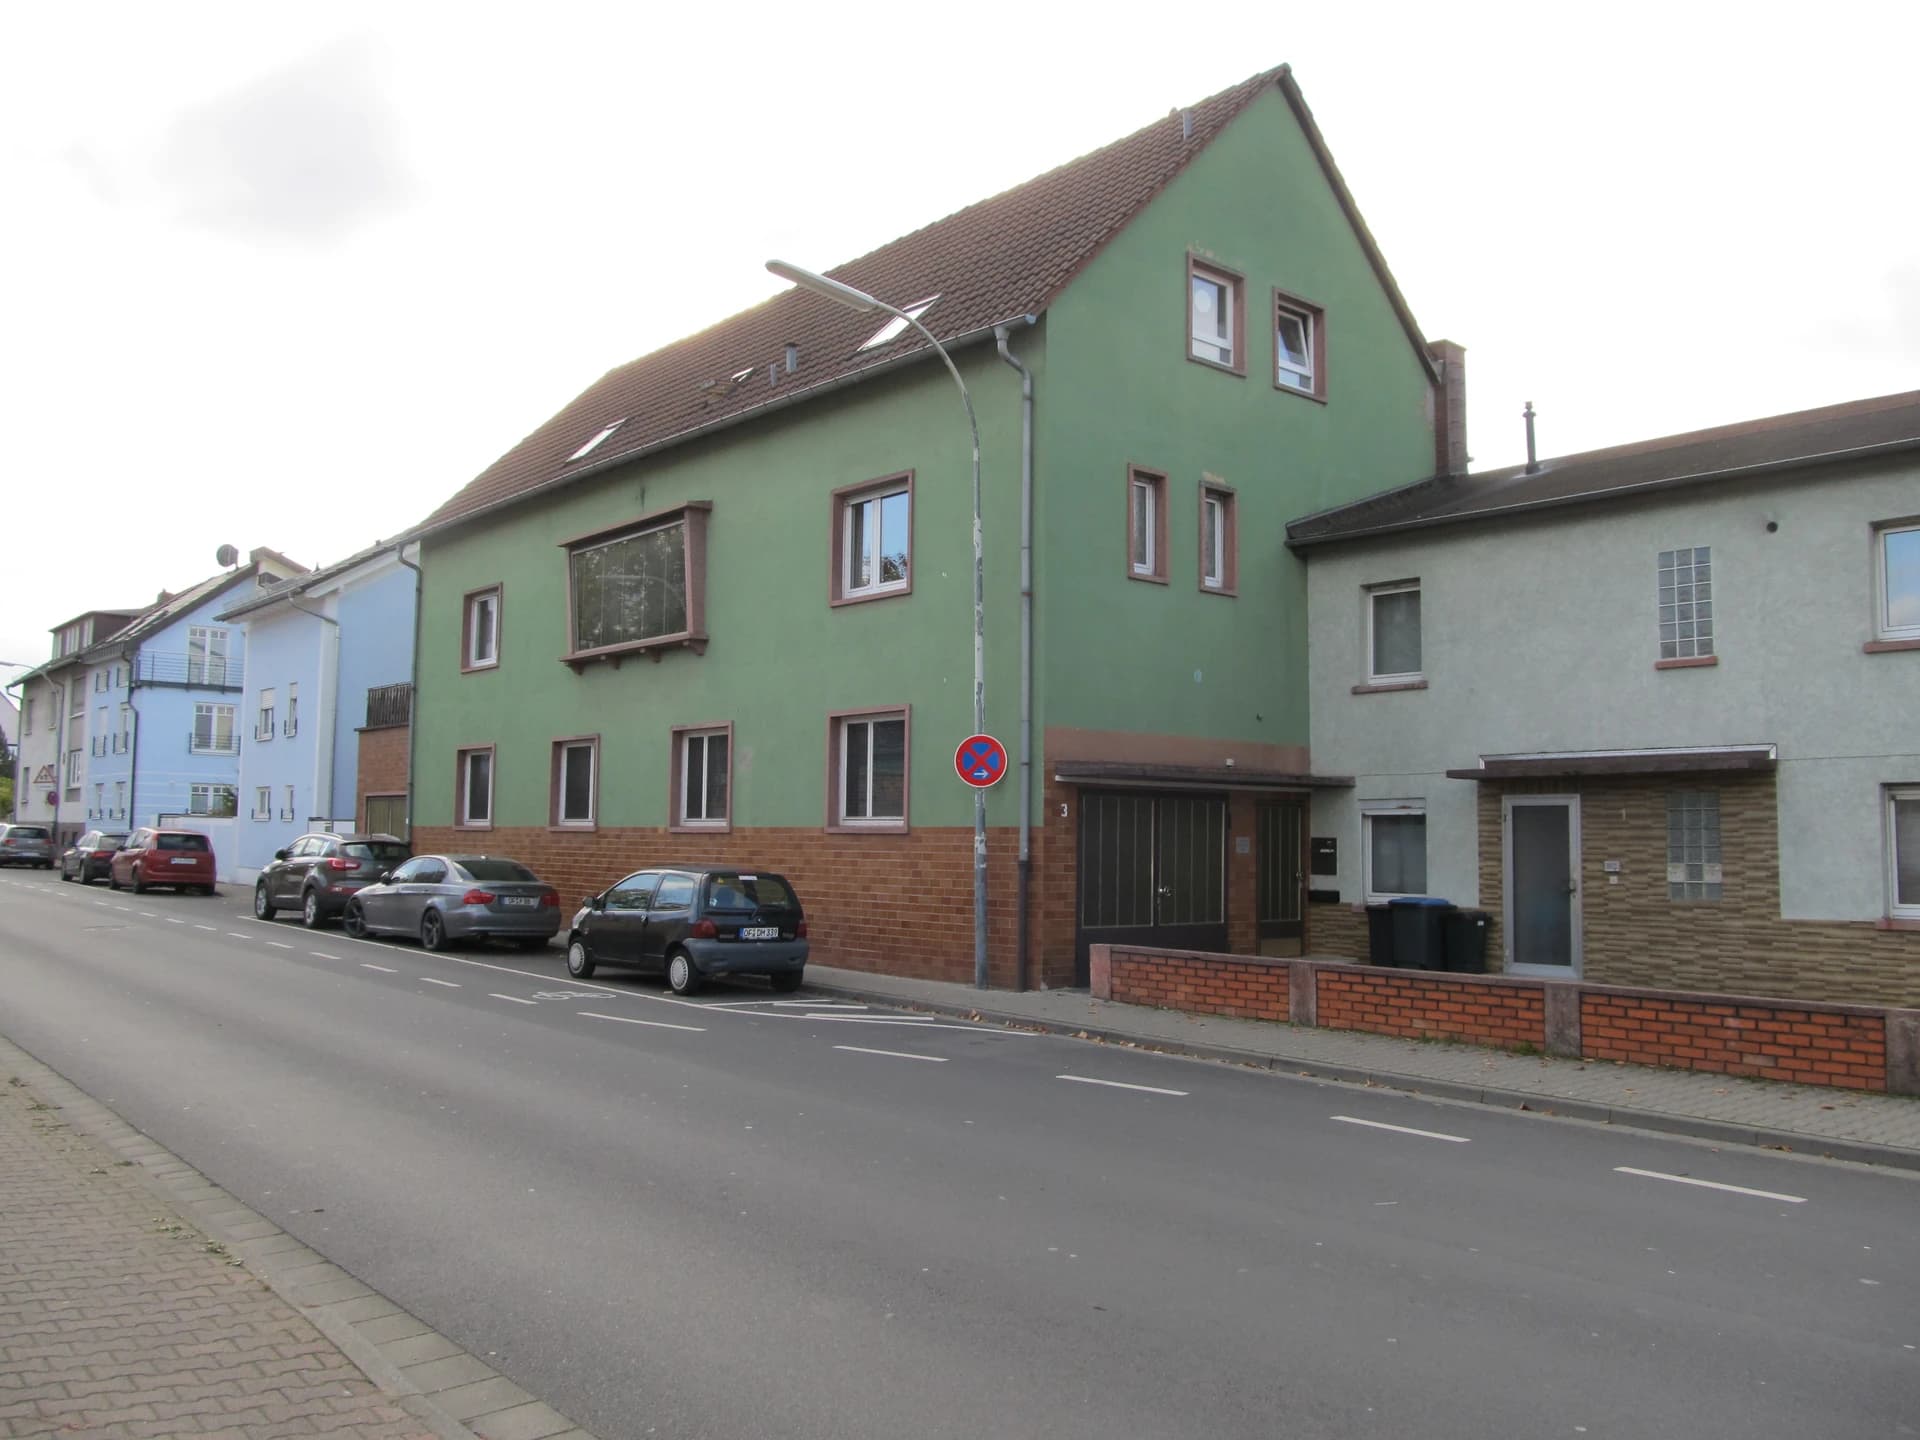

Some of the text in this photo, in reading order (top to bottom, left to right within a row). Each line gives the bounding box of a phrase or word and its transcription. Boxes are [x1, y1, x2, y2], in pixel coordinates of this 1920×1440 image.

[1060, 803, 1068, 817] 3
[744, 928, 778, 937] OF DM 339
